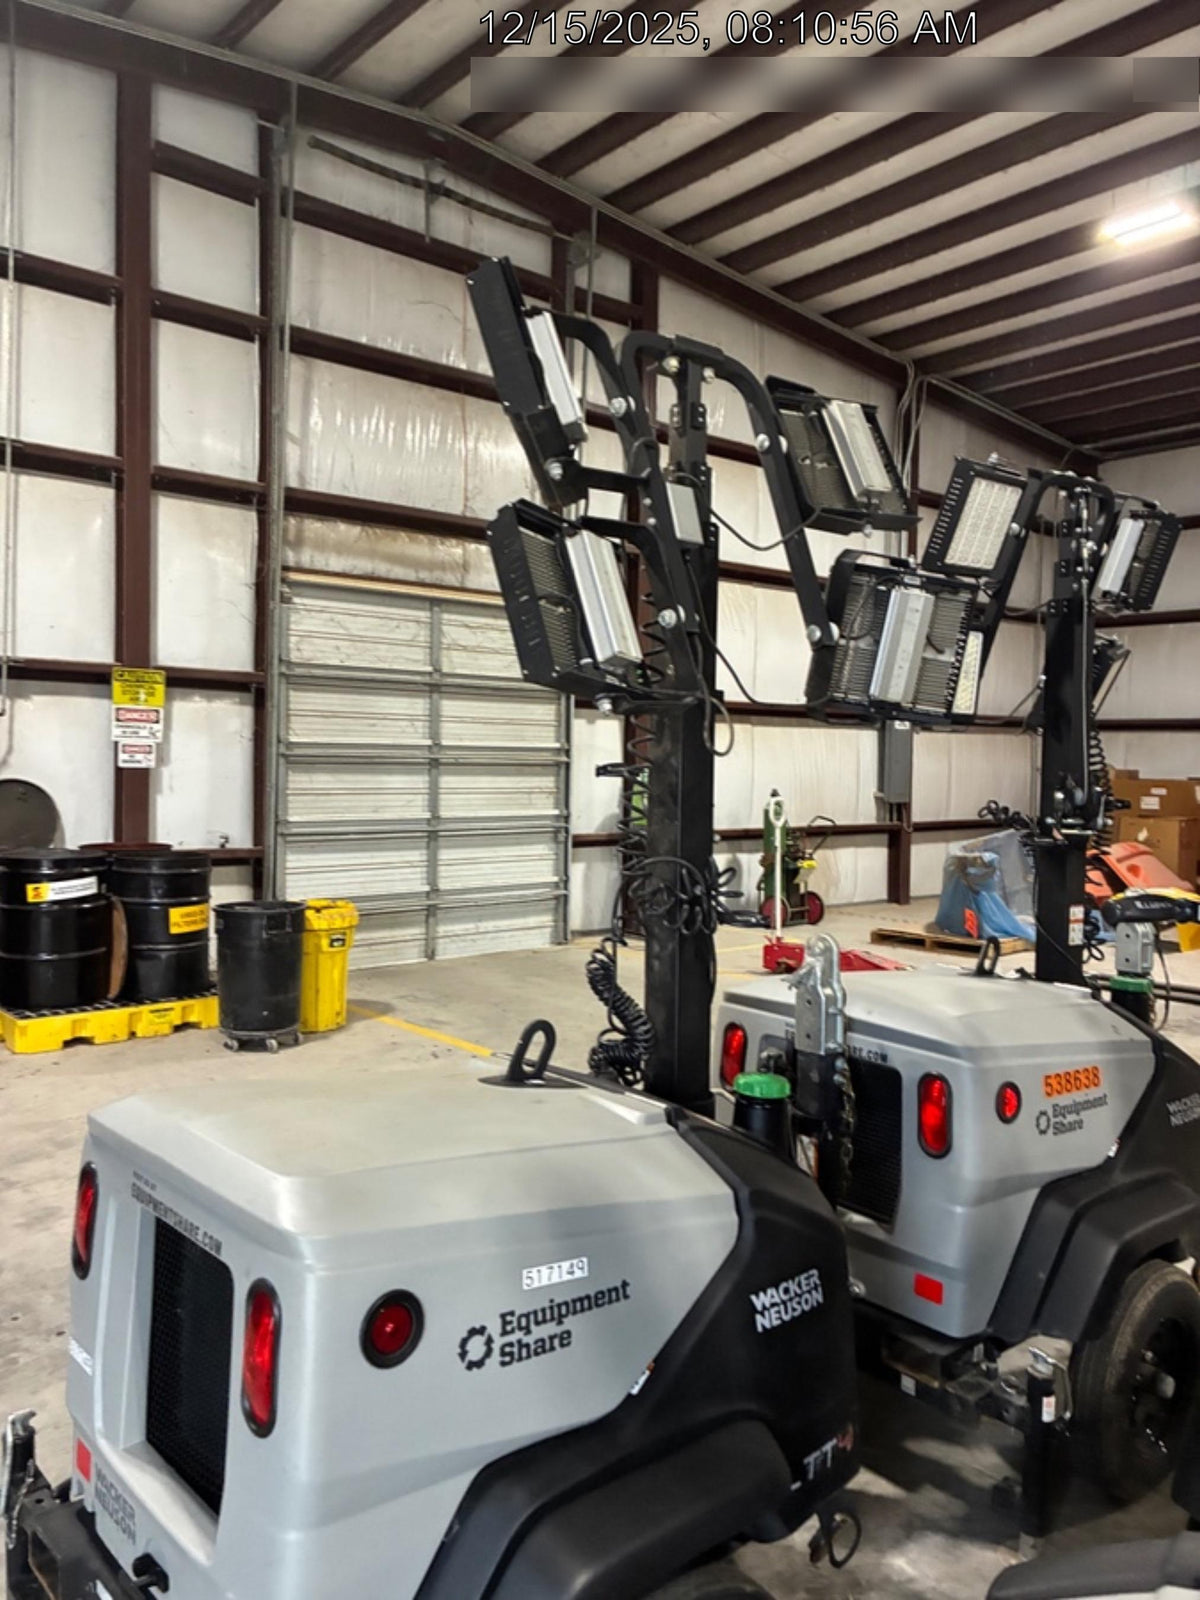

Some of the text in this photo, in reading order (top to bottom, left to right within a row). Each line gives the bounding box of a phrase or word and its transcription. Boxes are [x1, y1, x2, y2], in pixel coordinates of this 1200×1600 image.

[1045, 1066, 1101, 1097] 538638
[1052, 1093, 1109, 1119] Equipment
[1053, 1117, 1084, 1136] Share
[525, 1259, 586, 1288] 517149
[749, 1268, 821, 1312] WACKER
[499, 1279, 631, 1336] Equipment
[755, 1286, 824, 1333] NEUSON
[499, 1329, 572, 1367] Share
